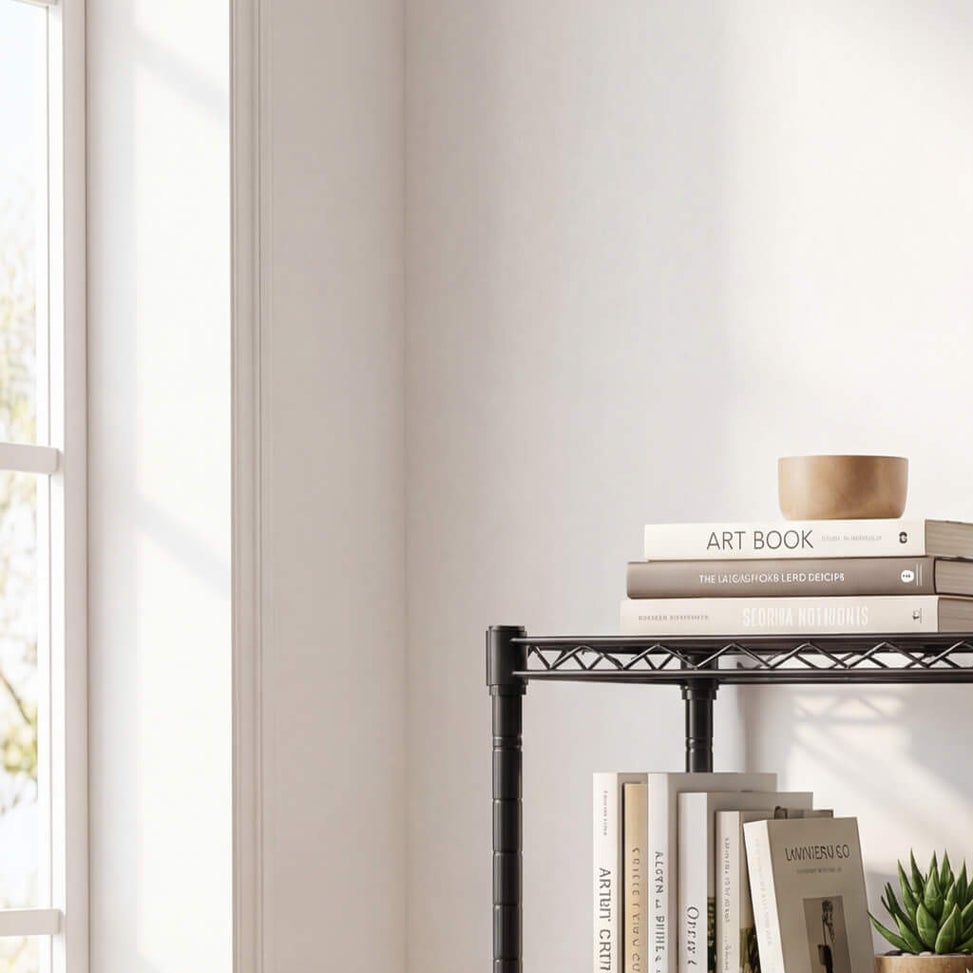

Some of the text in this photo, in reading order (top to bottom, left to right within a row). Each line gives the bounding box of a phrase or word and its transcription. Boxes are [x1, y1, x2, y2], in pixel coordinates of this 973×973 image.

[706, 529, 814, 551] ART BOOK
[699, 574, 715, 583] THE
